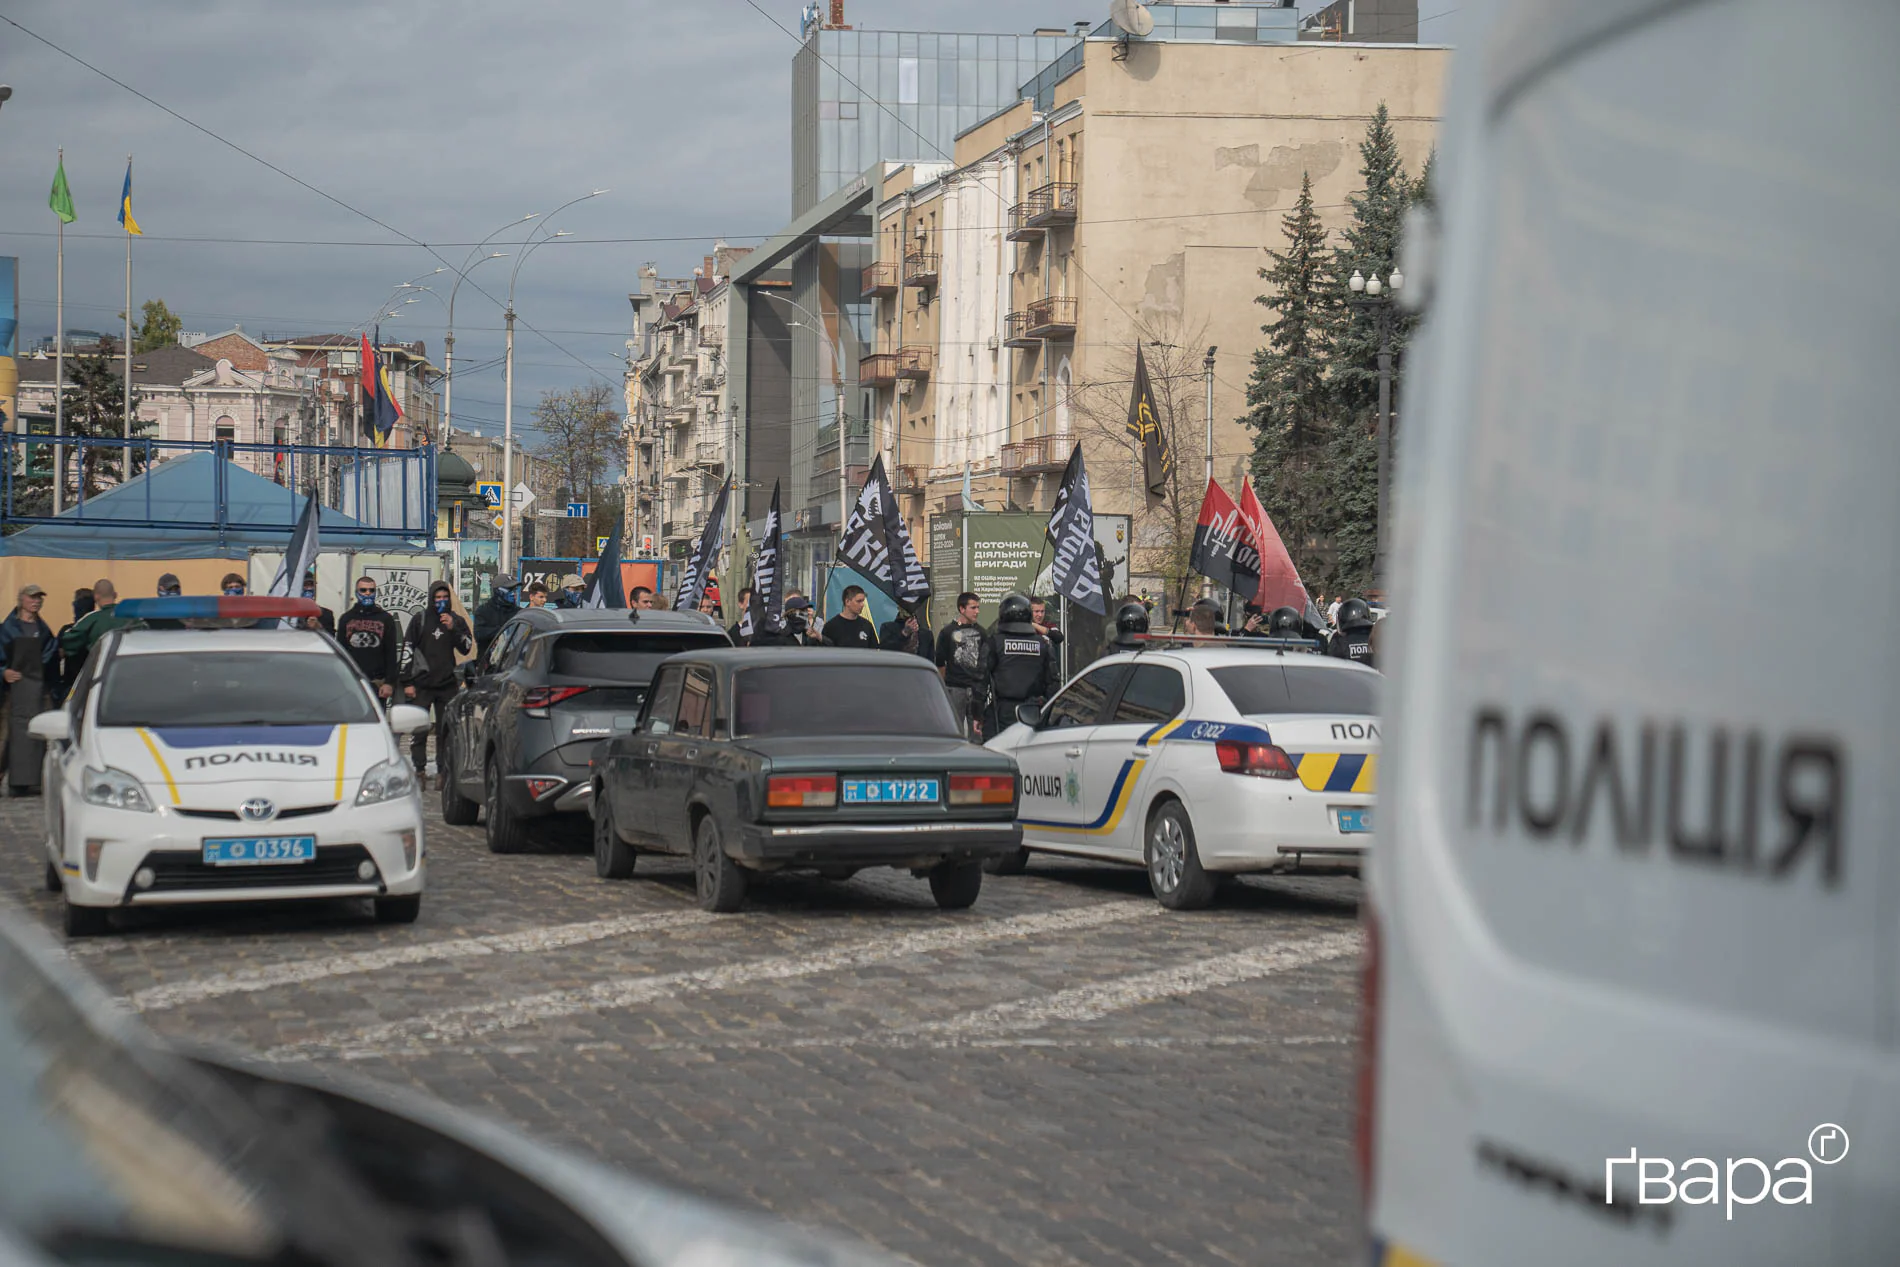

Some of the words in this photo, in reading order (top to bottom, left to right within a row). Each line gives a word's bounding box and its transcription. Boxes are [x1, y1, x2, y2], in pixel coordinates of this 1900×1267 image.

[974, 541, 1029, 549] ПОТОЧНА
[974, 551, 1042, 559] ДІЯЛЬНІСТЬ
[974, 560, 1027, 569] БРИГАДИ
[376, 584, 428, 602] АКРУЧУЙ
[382, 597, 411, 609] СЕБЕ
[1005, 641, 1040, 652] ПОЛІЦІЯ
[184, 752, 319, 770] ПОЛІЦІЯ
[888, 783, 929, 800] 1722
[1468, 704, 1846, 888] ПОЛІЦІЯ
[254, 839, 304, 859] 0396
